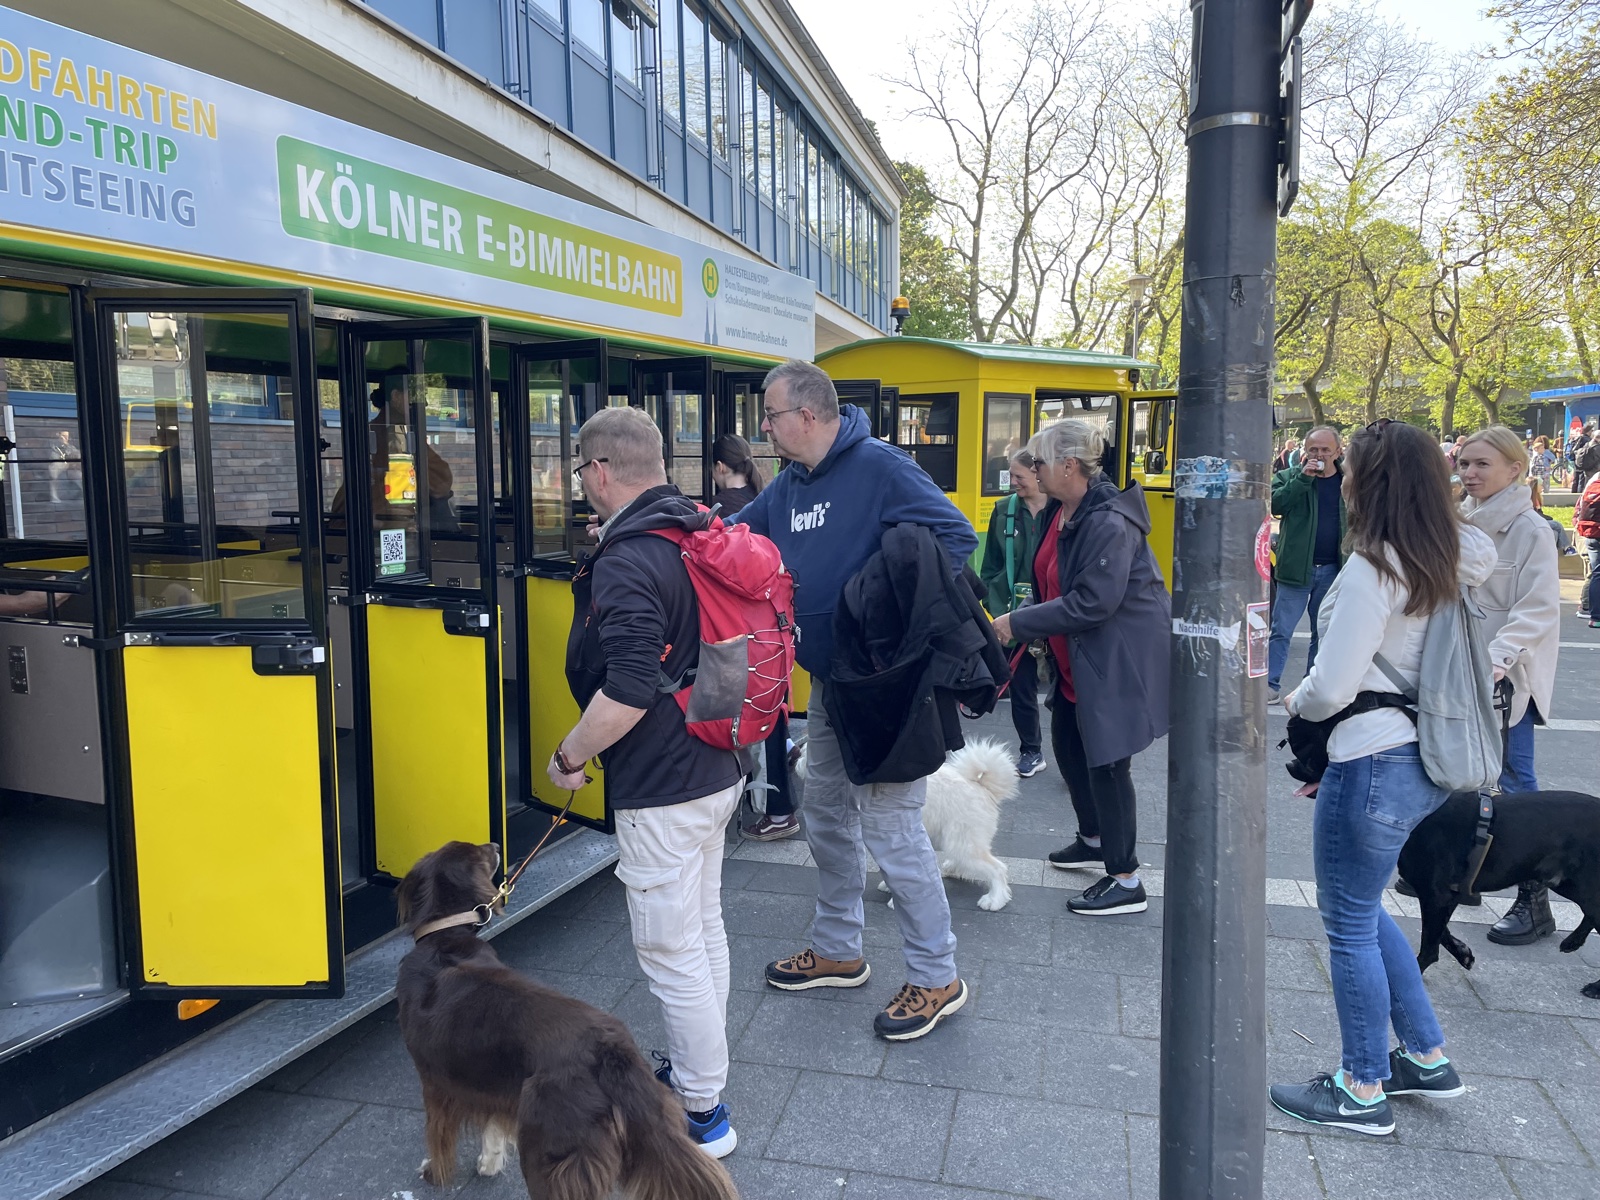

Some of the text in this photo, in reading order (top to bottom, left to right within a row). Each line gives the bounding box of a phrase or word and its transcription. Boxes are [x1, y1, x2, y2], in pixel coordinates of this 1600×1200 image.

[296, 162, 676, 304] KÖLNER E-BIMMELBAHN
[706, 265, 715, 291] H
[725, 326, 788, 347] www.bimmelbahnen.de
[1178, 623, 1219, 636] Nachhilfe
